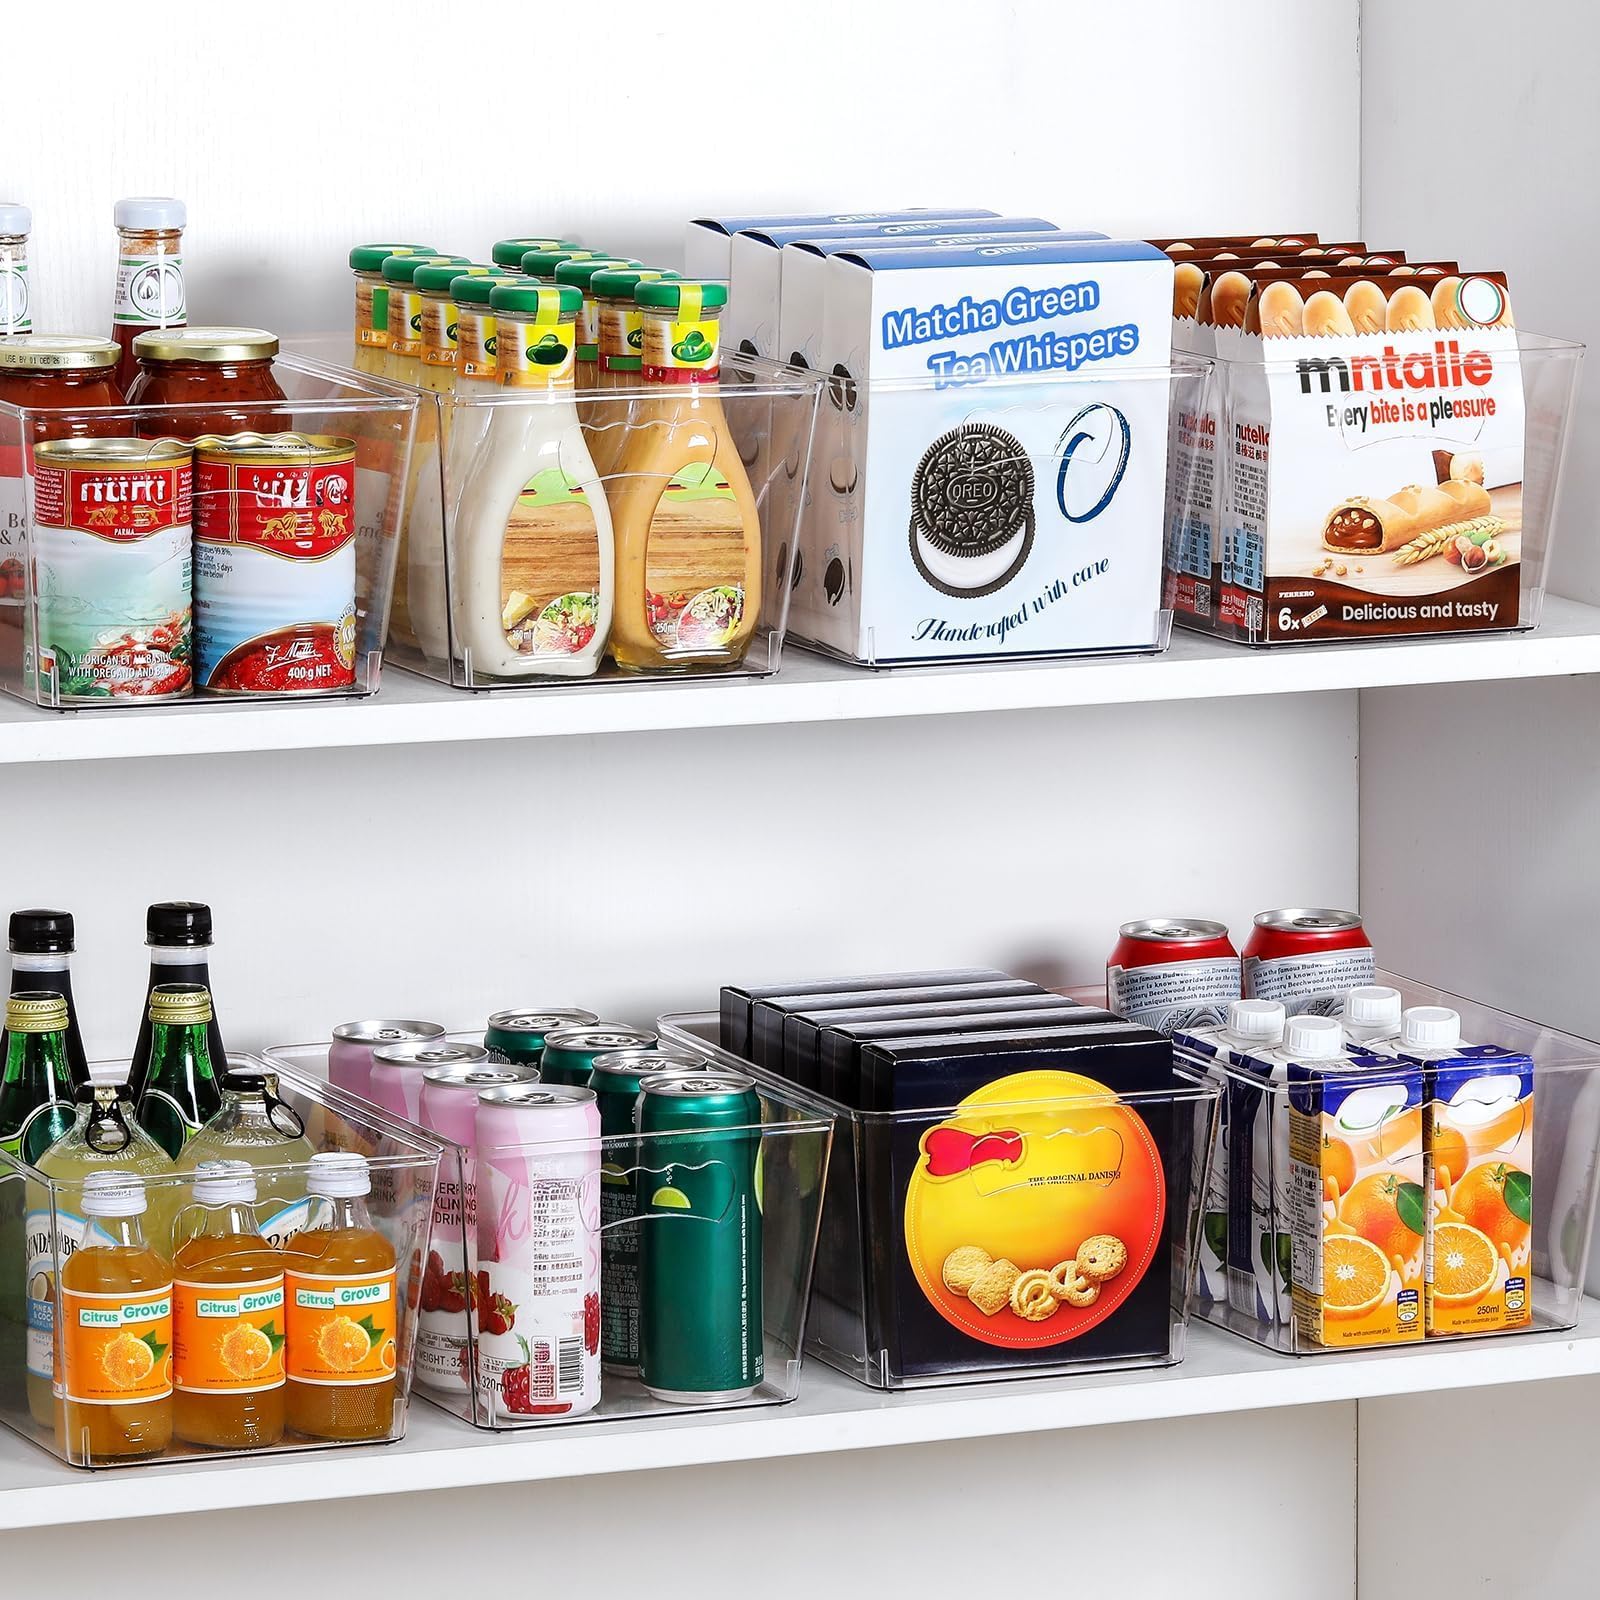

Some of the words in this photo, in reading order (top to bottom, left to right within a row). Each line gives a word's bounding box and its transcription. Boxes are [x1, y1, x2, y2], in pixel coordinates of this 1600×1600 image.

[884, 299, 998, 346] Matcha
[1004, 283, 1097, 322] Green
[930, 355, 987, 387] Tea
[994, 325, 1136, 375] Whispers
[1296, 340, 1493, 394] mntalle
[1370, 398, 1400, 425] bite
[1401, 397, 1415, 422] is
[1418, 401, 1428, 421] a
[1430, 396, 1496, 428] pleasure
[952, 484, 992, 499] OREO
[114, 528, 135, 536] PARMA
[911, 603, 1028, 645] Handcrafted
[1033, 579, 1068, 613] with
[1072, 558, 1109, 586] care
[1342, 603, 1417, 621] Delicious
[1420, 602, 1453, 618] and
[1455, 601, 1499, 621] tasty
[68, 666, 91, 677] WITH
[93, 667, 136, 679] OREGANO
[316, 664, 332, 677] NET
[1278, 965, 1301, 975] famous
[1318, 966, 1352, 975] worldwide
[1139, 975, 1161, 984] famous
[1179, 975, 1213, 985] worldwide
[1287, 977, 1325, 988] Beechwood
[1149, 986, 1186, 997] Beechwood
[1312, 984, 1337, 992] smooth
[1174, 993, 1198, 1001] smooth
[297, 1293, 335, 1305] Citrus
[341, 1286, 380, 1302] Grove
[200, 1302, 237, 1313] Citrus
[243, 1292, 282, 1310] Grove
[81, 1312, 118, 1322] Citrus
[124, 1304, 169, 1318] Grove
[1477, 1305, 1500, 1315] 250ml
